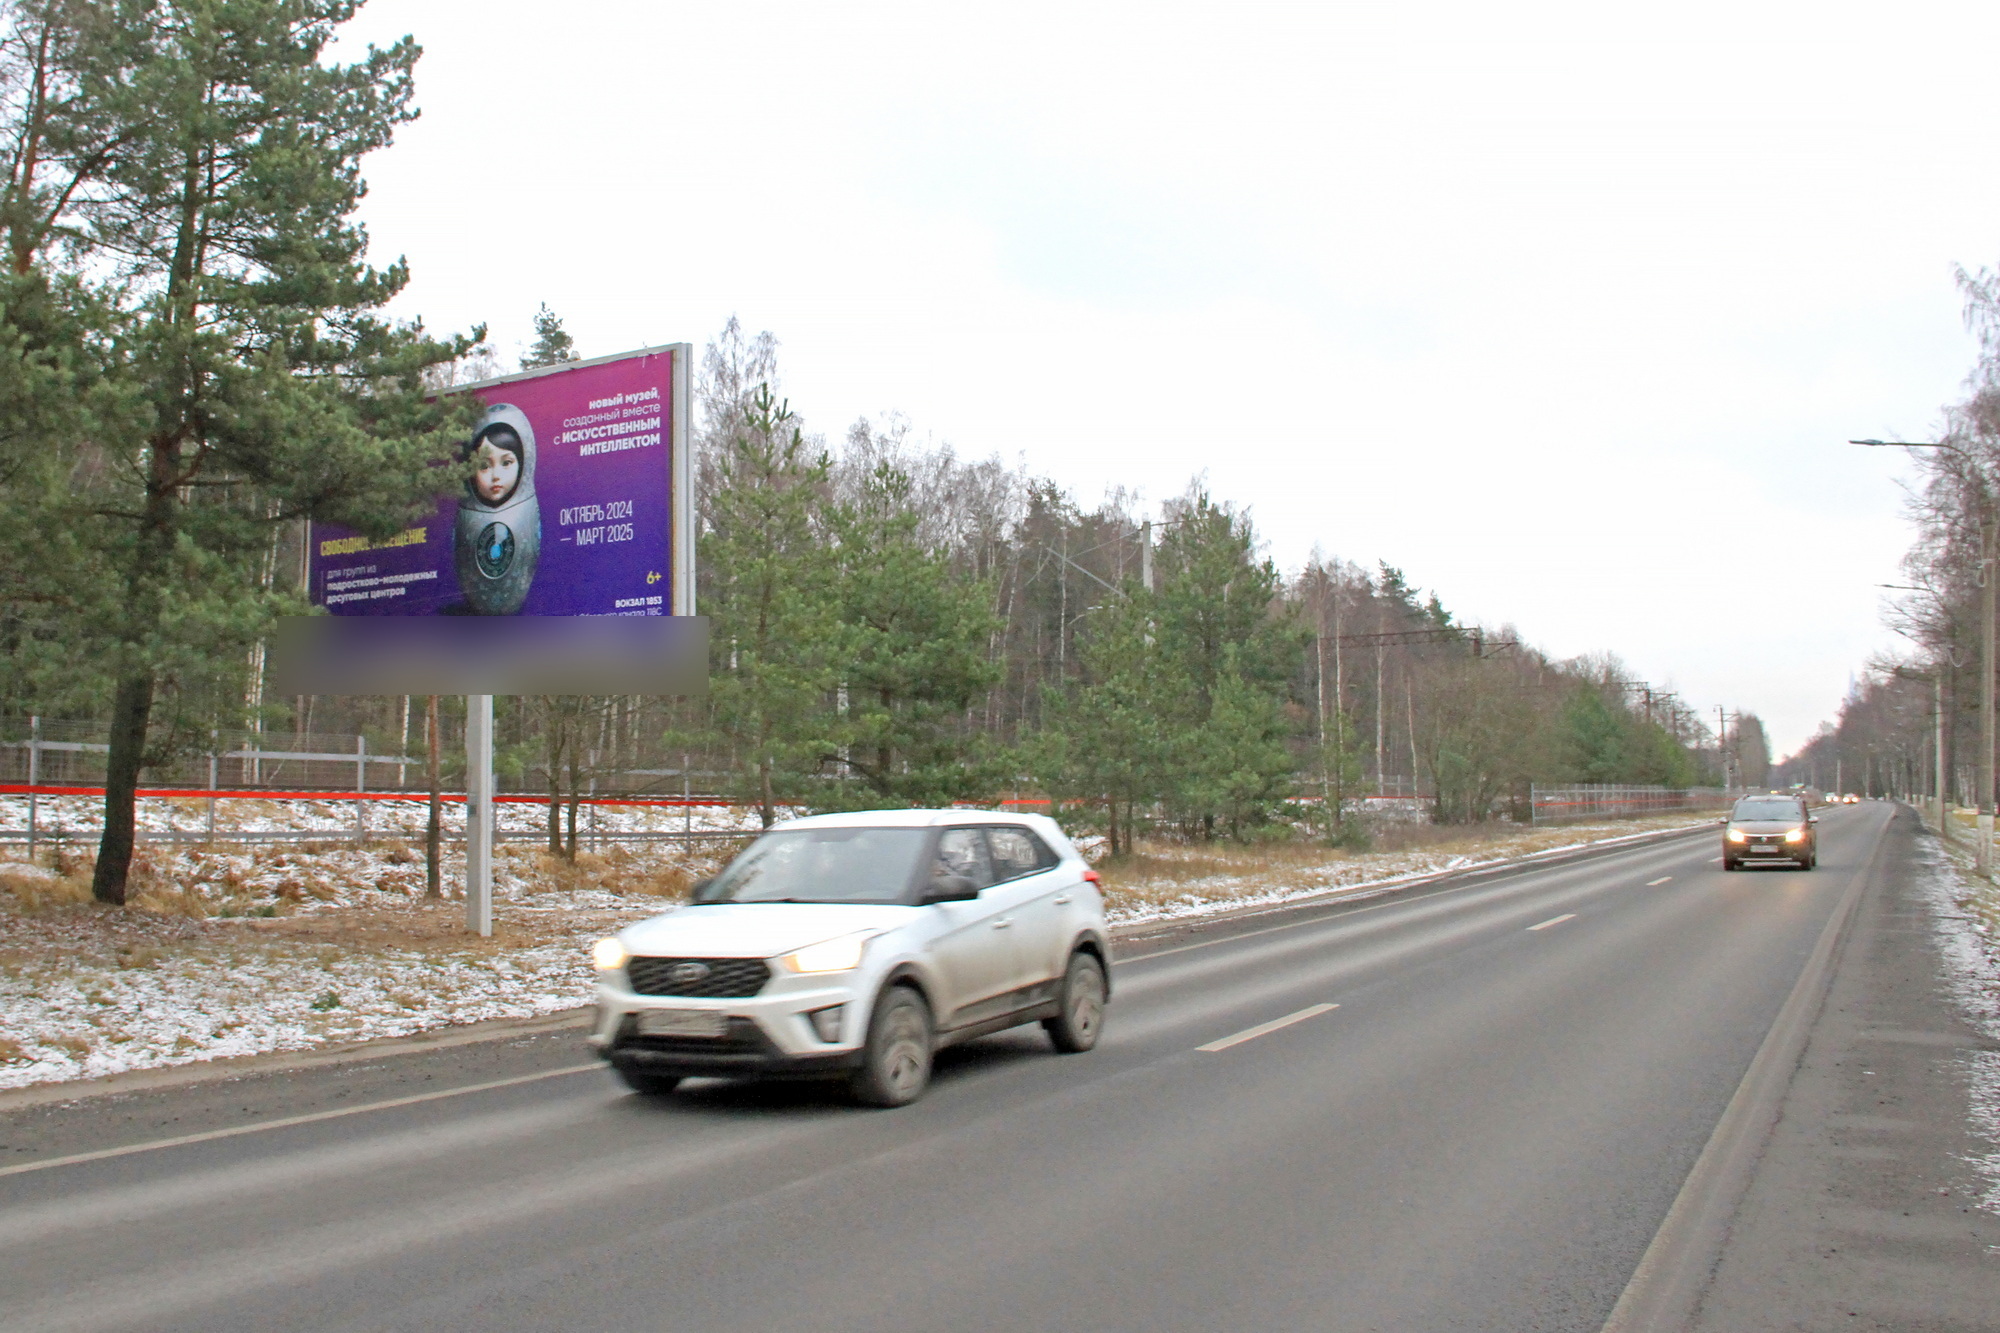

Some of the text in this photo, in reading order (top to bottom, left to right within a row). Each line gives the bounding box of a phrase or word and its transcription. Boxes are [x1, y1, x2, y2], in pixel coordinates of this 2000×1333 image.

[589, 387, 660, 409] новый музей,
[563, 403, 660, 427] созданный вместе
[553, 417, 660, 445] с ИСКУССТВЕННЫМ
[580, 433, 660, 456] ИНТЕЛЛЕКТОМ
[560, 500, 633, 526] ОКТЯБРЬ 2024
[576, 526, 605, 546] МАРТ
[607, 523, 634, 542] 2025
[646, 571, 662, 584] 6+
[615, 595, 662, 608] ВОКЗАЛ 1853
